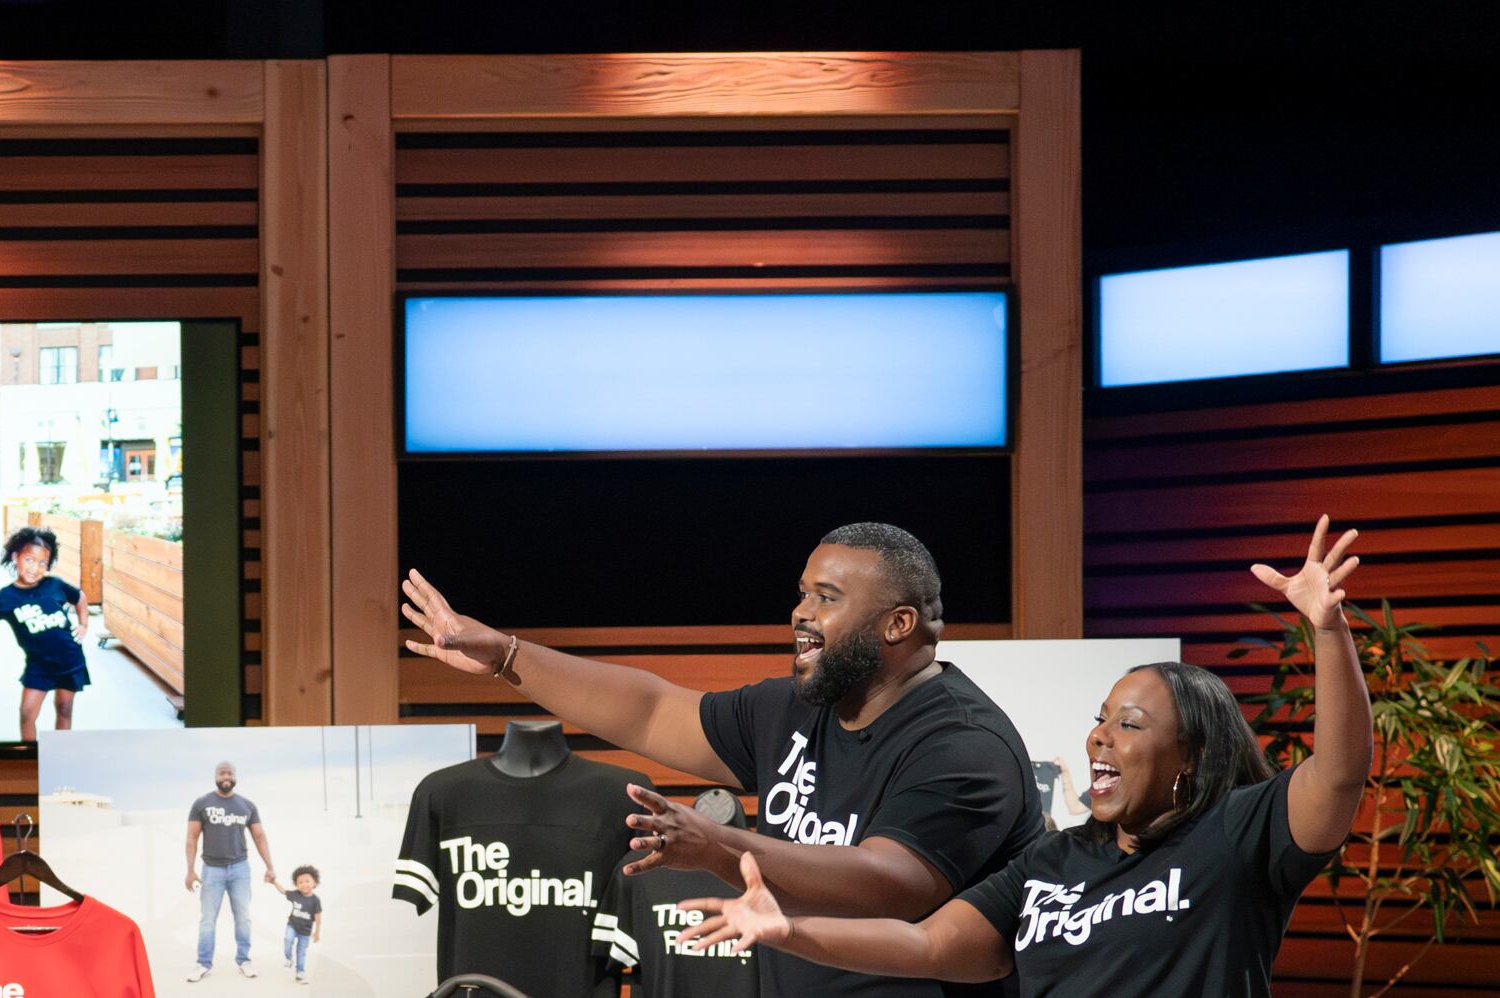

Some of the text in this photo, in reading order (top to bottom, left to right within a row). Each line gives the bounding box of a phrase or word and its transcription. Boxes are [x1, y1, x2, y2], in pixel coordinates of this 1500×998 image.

[439, 836, 510, 875] The
[456, 868, 598, 917] Original.
[651, 903, 705, 928] The
